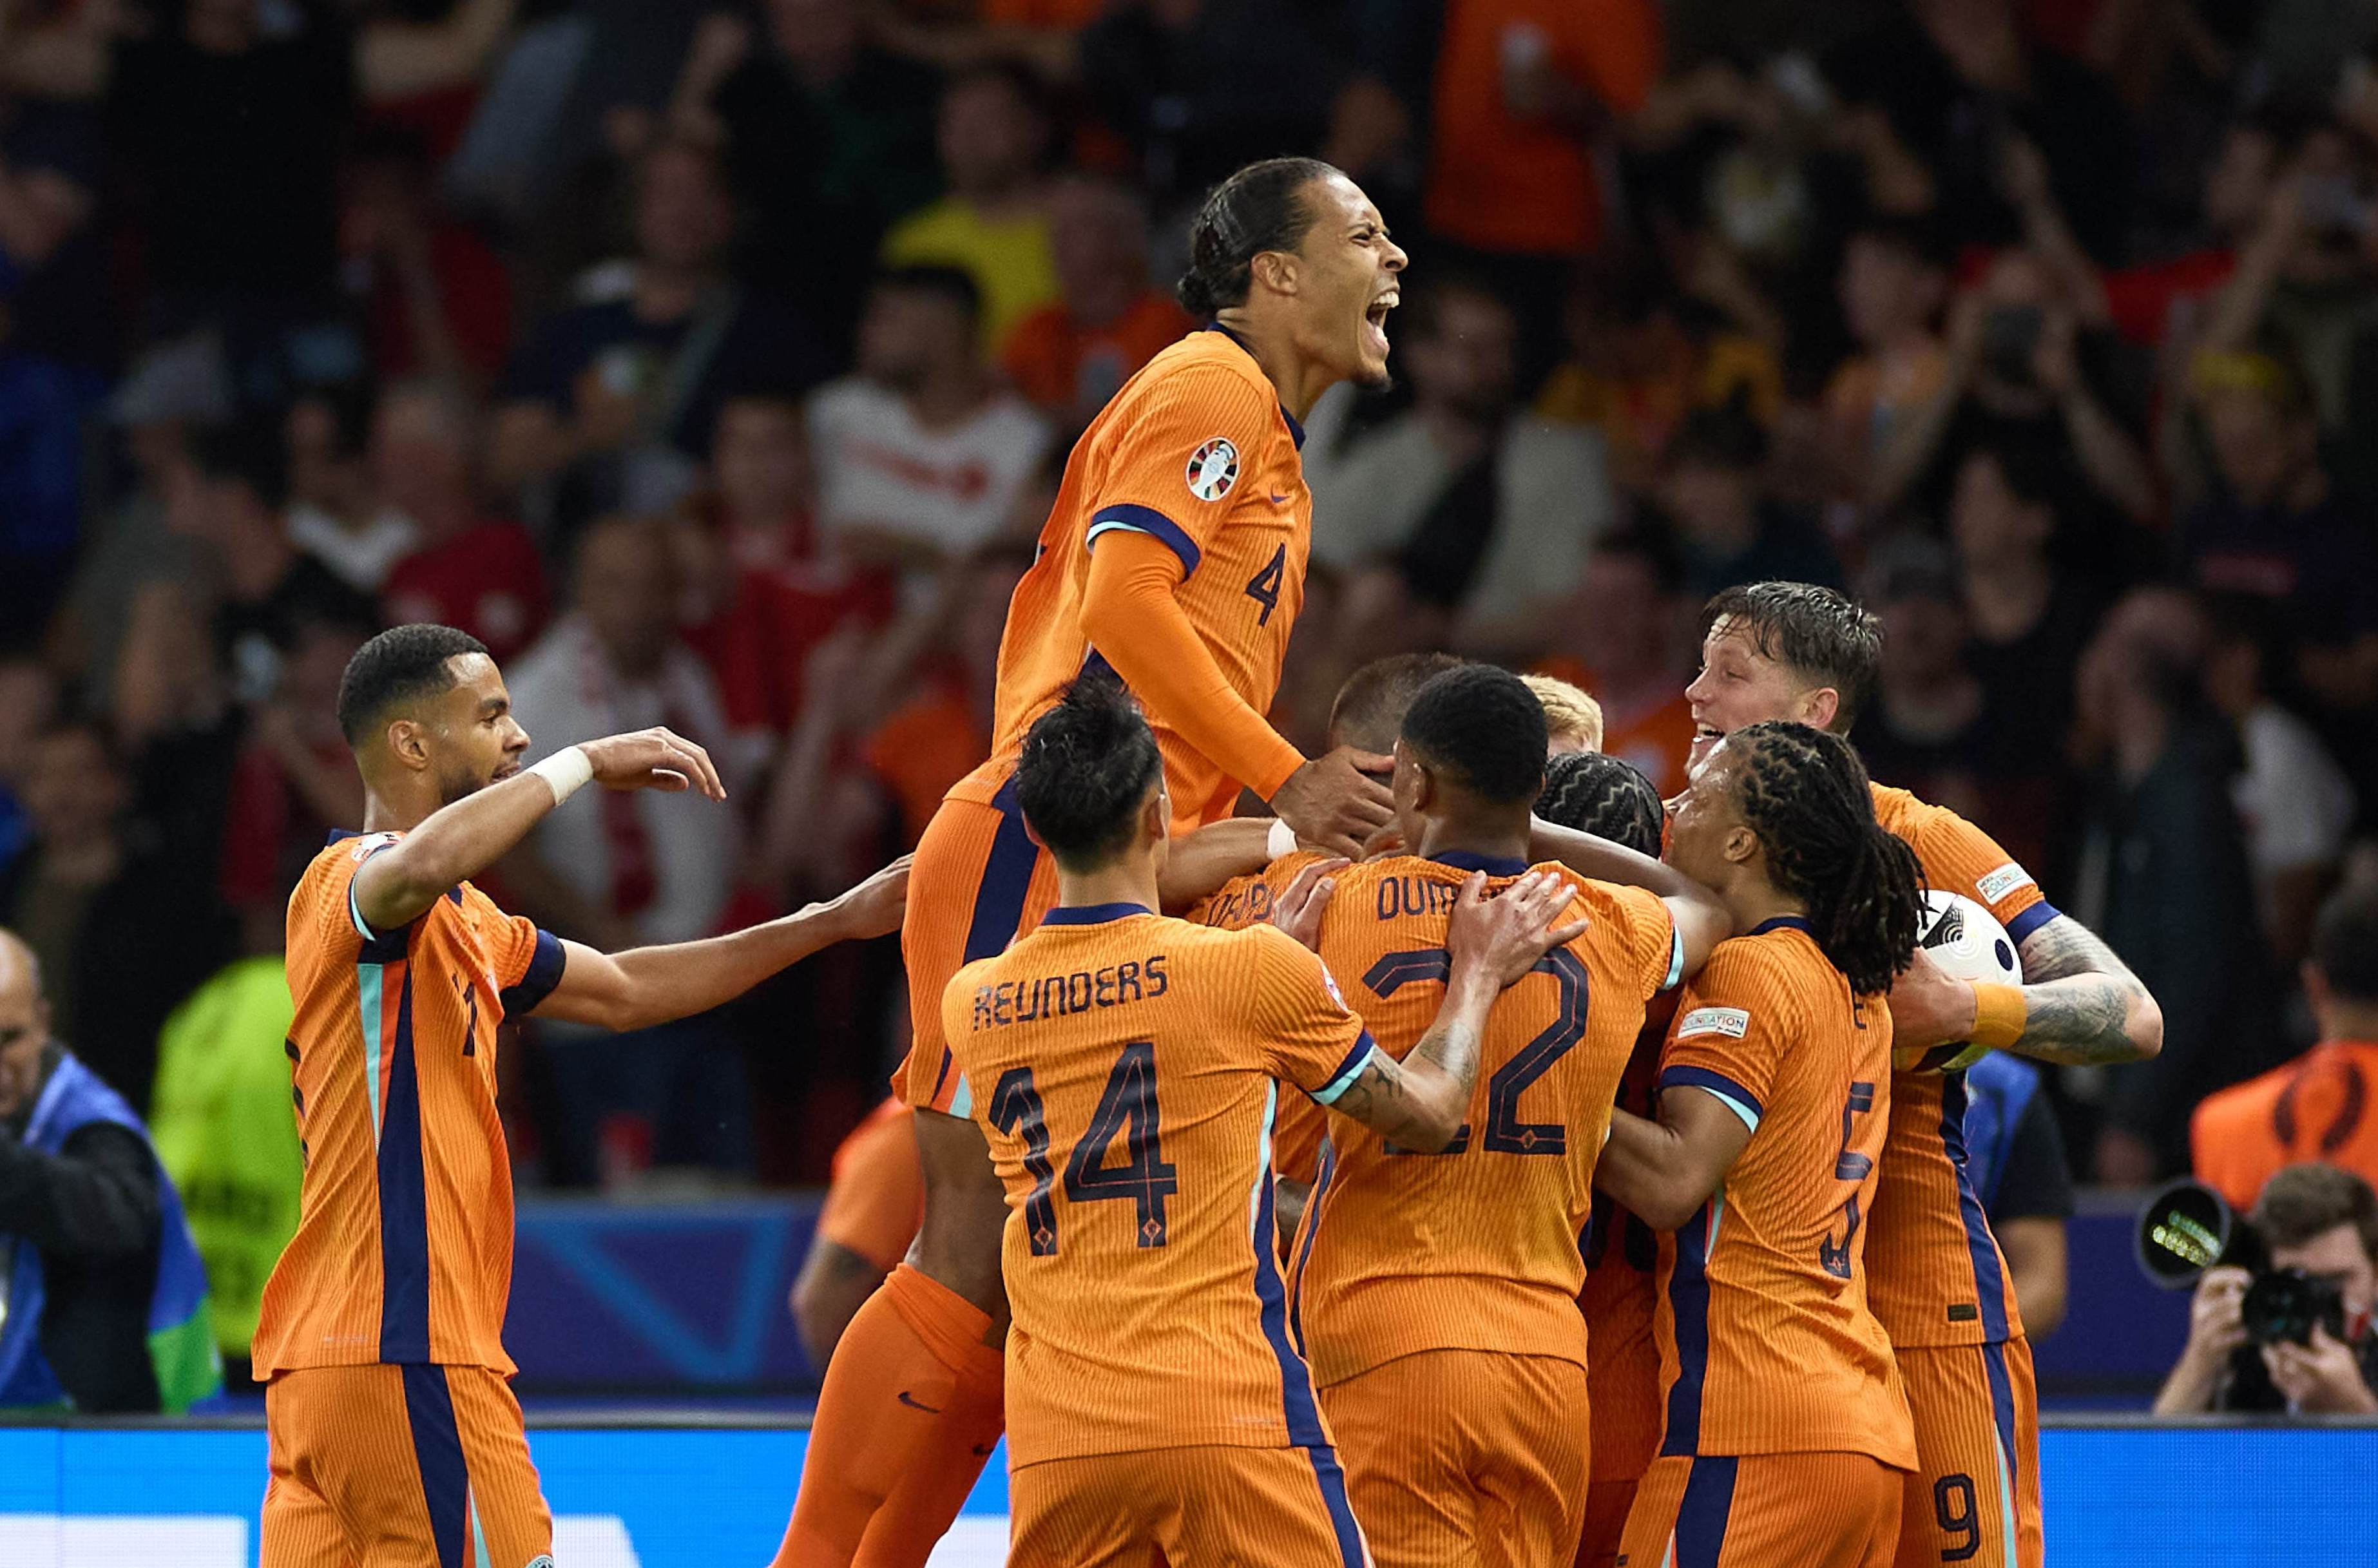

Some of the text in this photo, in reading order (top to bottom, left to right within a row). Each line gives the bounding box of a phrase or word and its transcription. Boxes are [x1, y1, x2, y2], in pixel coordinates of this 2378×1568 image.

[1245, 543, 1285, 627] 4
[989, 1042, 1177, 1256] 14
[1935, 1473, 1980, 1562] 9
